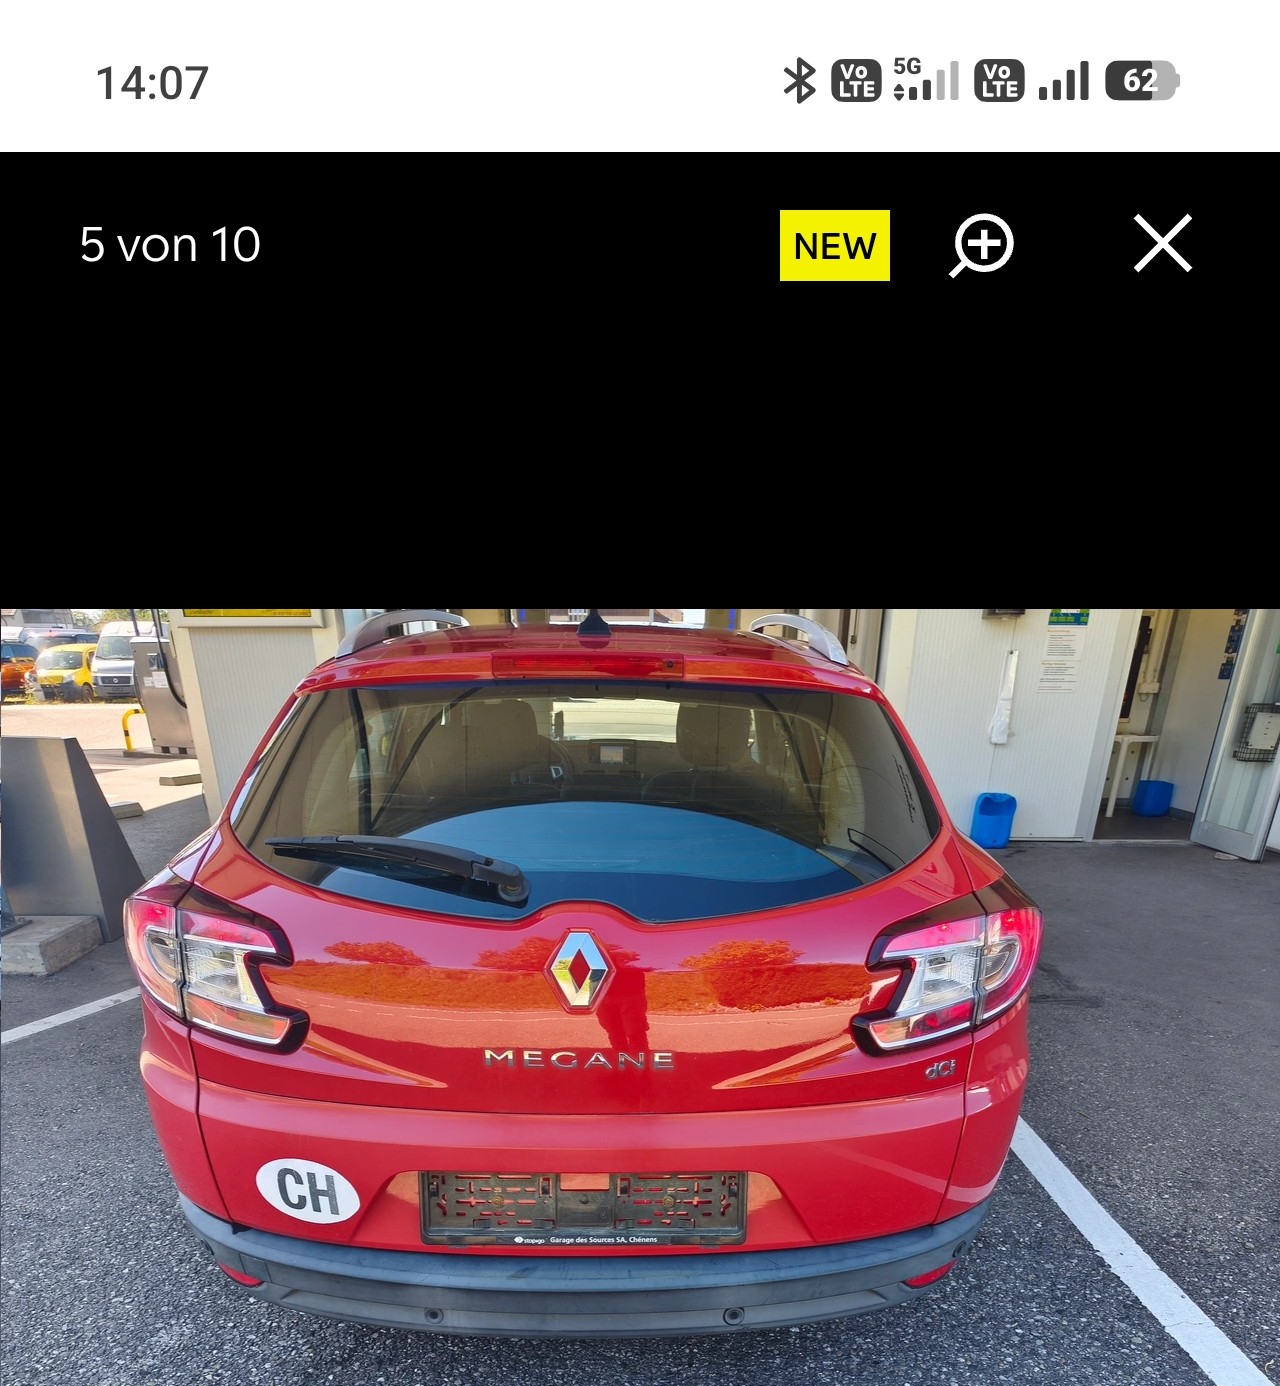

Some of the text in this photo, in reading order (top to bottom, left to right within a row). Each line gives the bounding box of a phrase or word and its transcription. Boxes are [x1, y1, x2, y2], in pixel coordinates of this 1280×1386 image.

[839, 63, 868, 80] Vo
[893, 57, 922, 75] 5G
[982, 63, 1011, 80] Vo
[96, 65, 209, 101] 14:07
[839, 81, 876, 98] LTE
[982, 81, 1019, 98] LTE
[1123, 68, 1159, 92] 62
[81, 226, 261, 263] 5 von 10
[794, 232, 877, 260] NEW
[484, 1049, 675, 1069] MEGANE
[277, 1167, 340, 1216] CH
[549, 1236, 574, 1245] Garage
[616, 1236, 628, 1244] SA,
